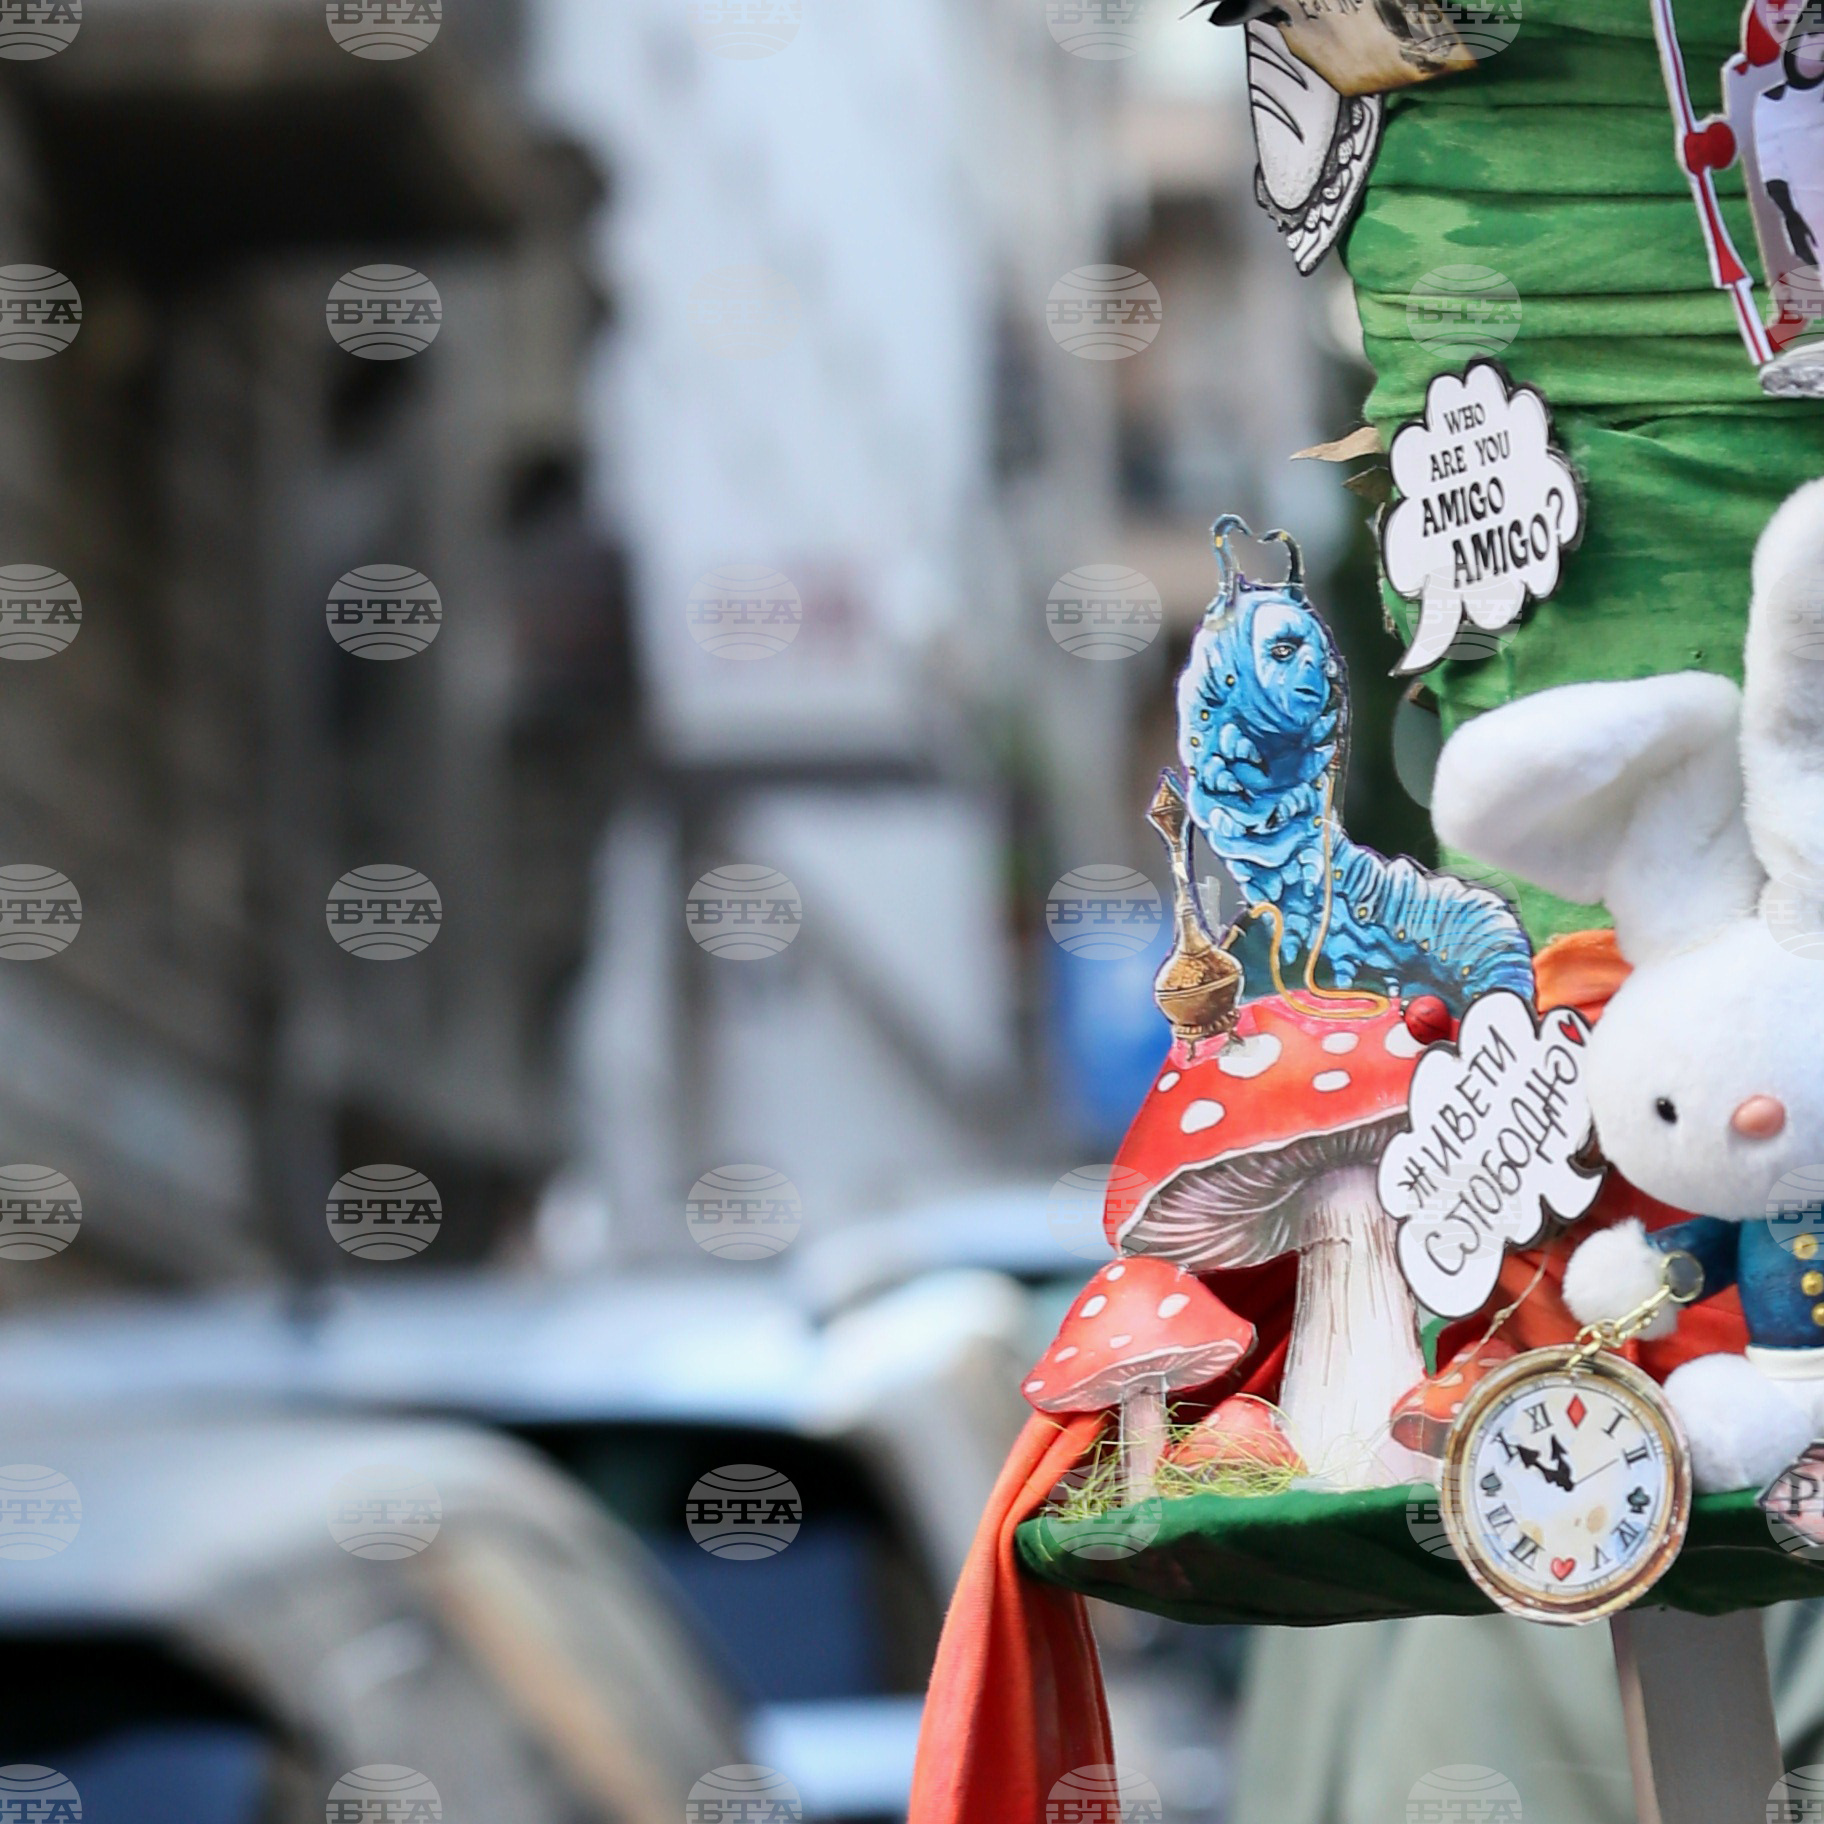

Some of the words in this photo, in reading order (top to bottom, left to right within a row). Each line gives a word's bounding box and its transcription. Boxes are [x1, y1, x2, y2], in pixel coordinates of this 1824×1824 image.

[1444, 403, 1486, 434] WHO
[1430, 446, 1467, 482] ARE
[1475, 430, 1511, 467] YOU
[1422, 477, 1505, 537] AMIGO
[1398, 1026, 1517, 1209] ЖИВЕТИ
[1425, 1045, 1579, 1276] СЛОБОДНО
